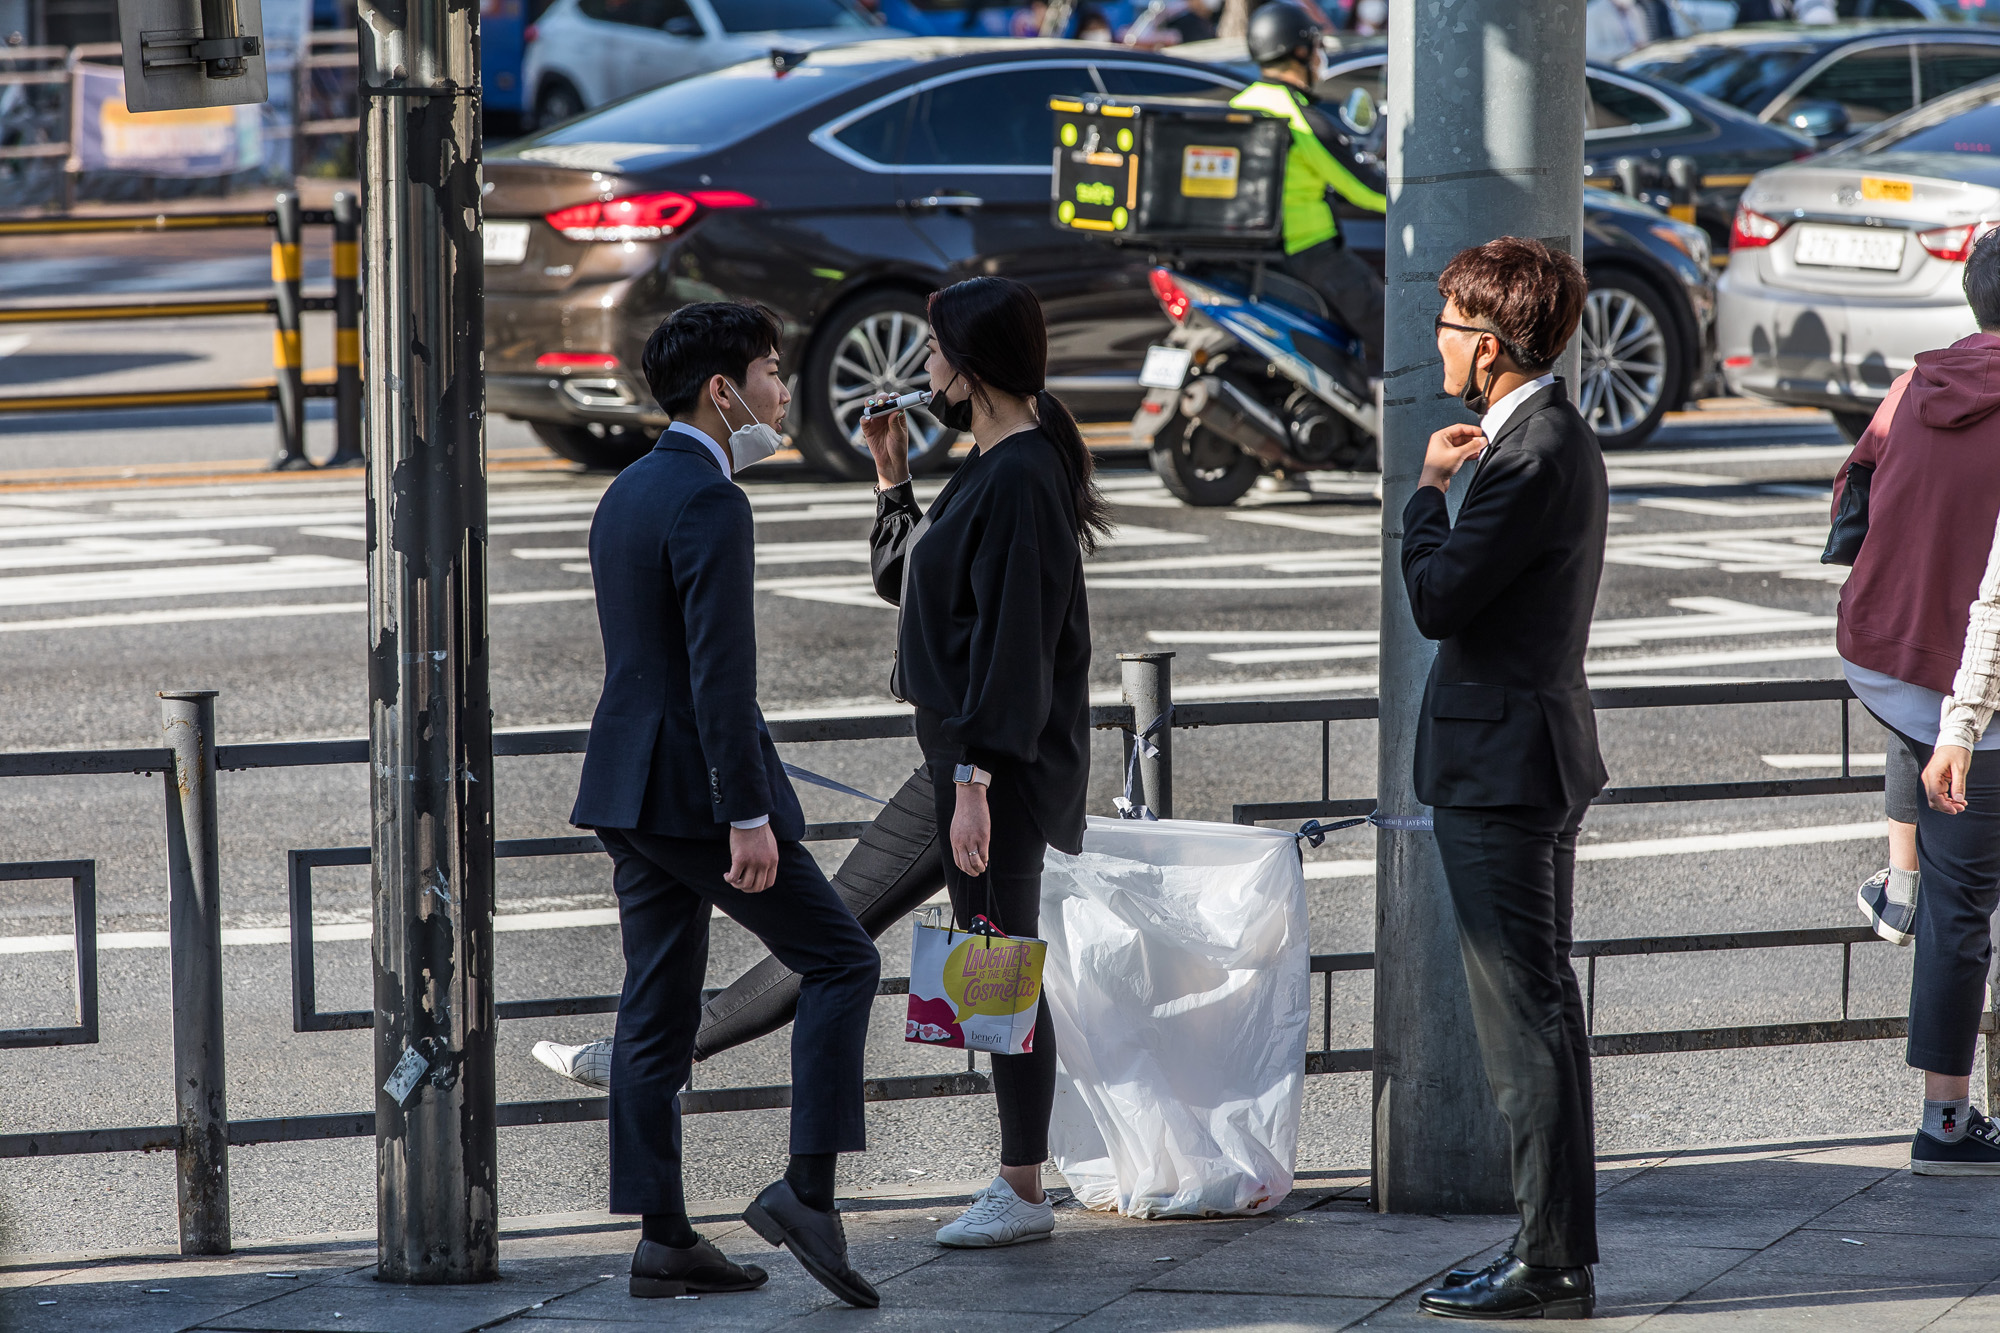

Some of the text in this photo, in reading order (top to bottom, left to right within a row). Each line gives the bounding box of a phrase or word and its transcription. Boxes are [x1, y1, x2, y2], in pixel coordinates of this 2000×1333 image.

[962, 944, 1031, 977] LAUGHTER
[979, 970, 986, 979] IS
[988, 969, 1002, 980] THE
[972, 1030, 1002, 1045] benefit
